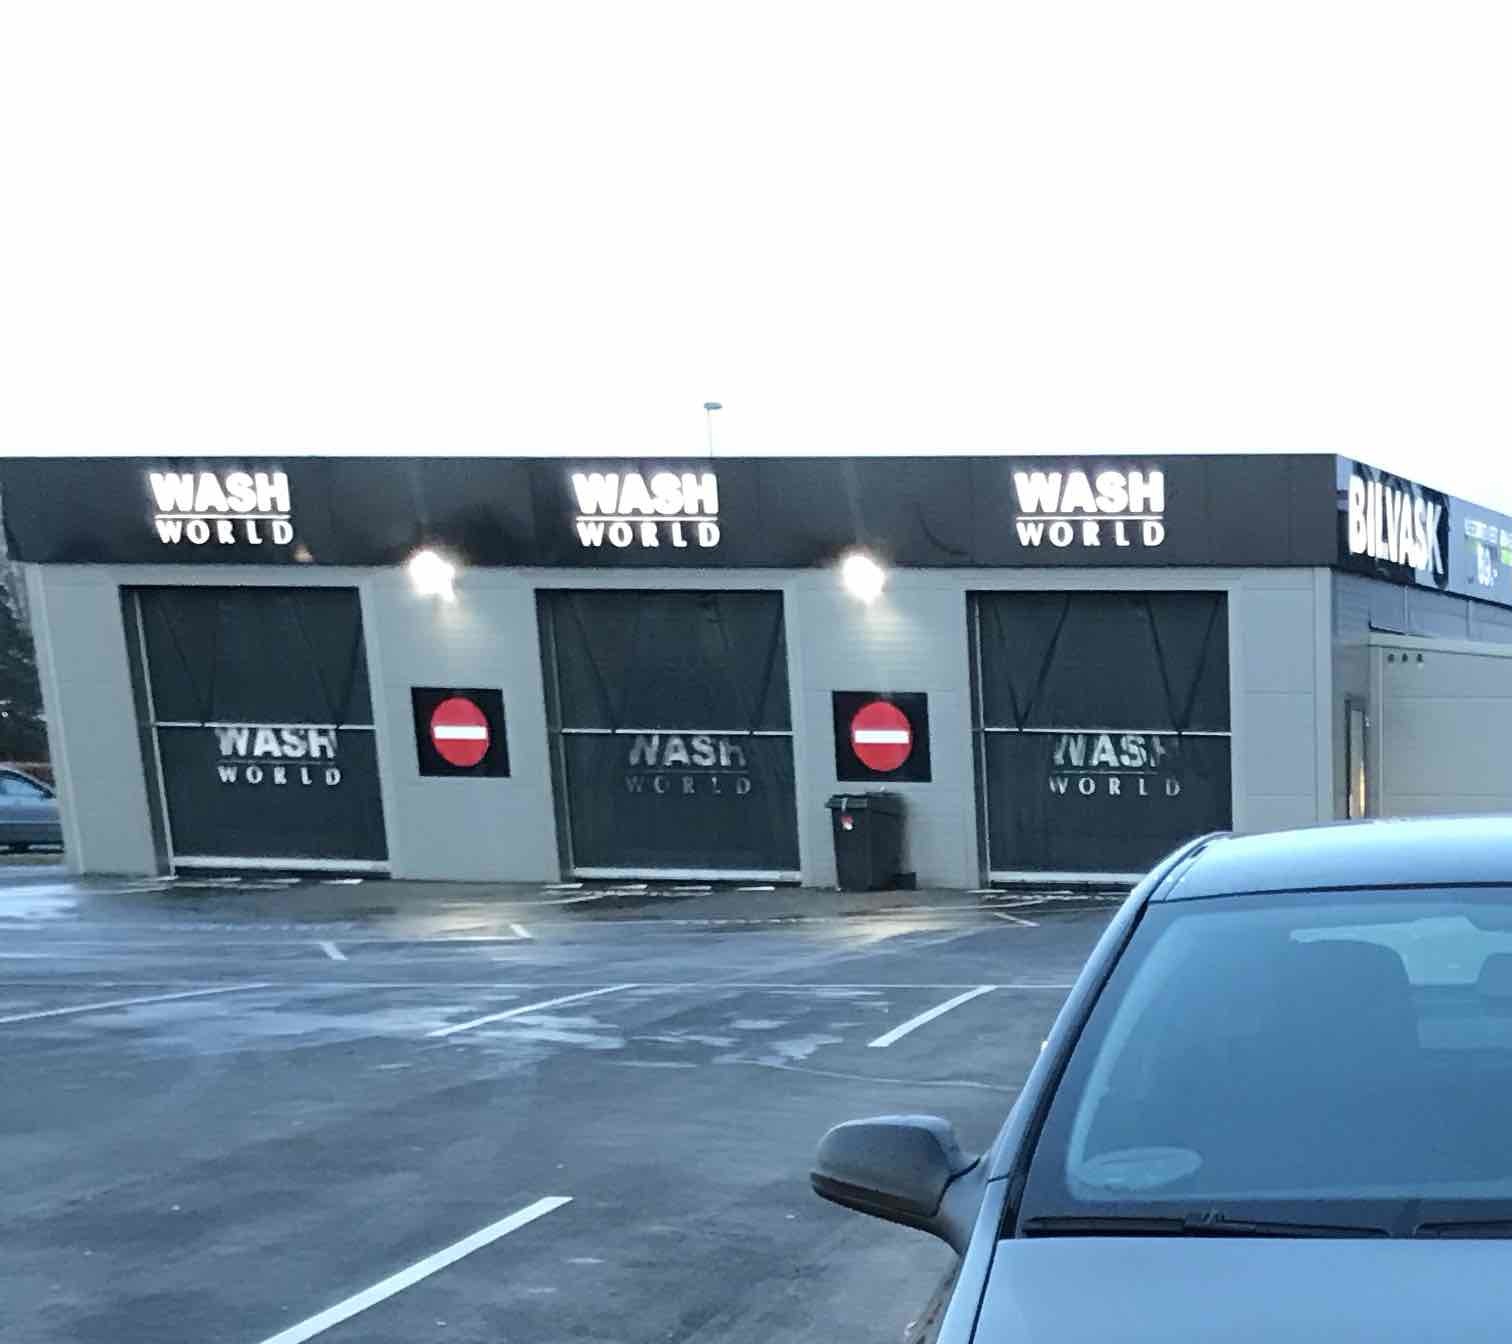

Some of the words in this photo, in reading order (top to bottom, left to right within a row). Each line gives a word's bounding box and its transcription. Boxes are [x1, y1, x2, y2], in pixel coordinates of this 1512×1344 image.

[149, 471, 291, 513] WASH
[571, 472, 719, 515] WASH
[1013, 471, 1165, 513] WASH
[155, 519, 294, 545] WORLD
[576, 521, 721, 548] WORLD
[1016, 520, 1165, 547] WORLD
[1349, 474, 1444, 575] BILVASK
[214, 727, 338, 759] WASH
[217, 765, 341, 786] WORLD
[1049, 776, 1181, 796] WORLD
